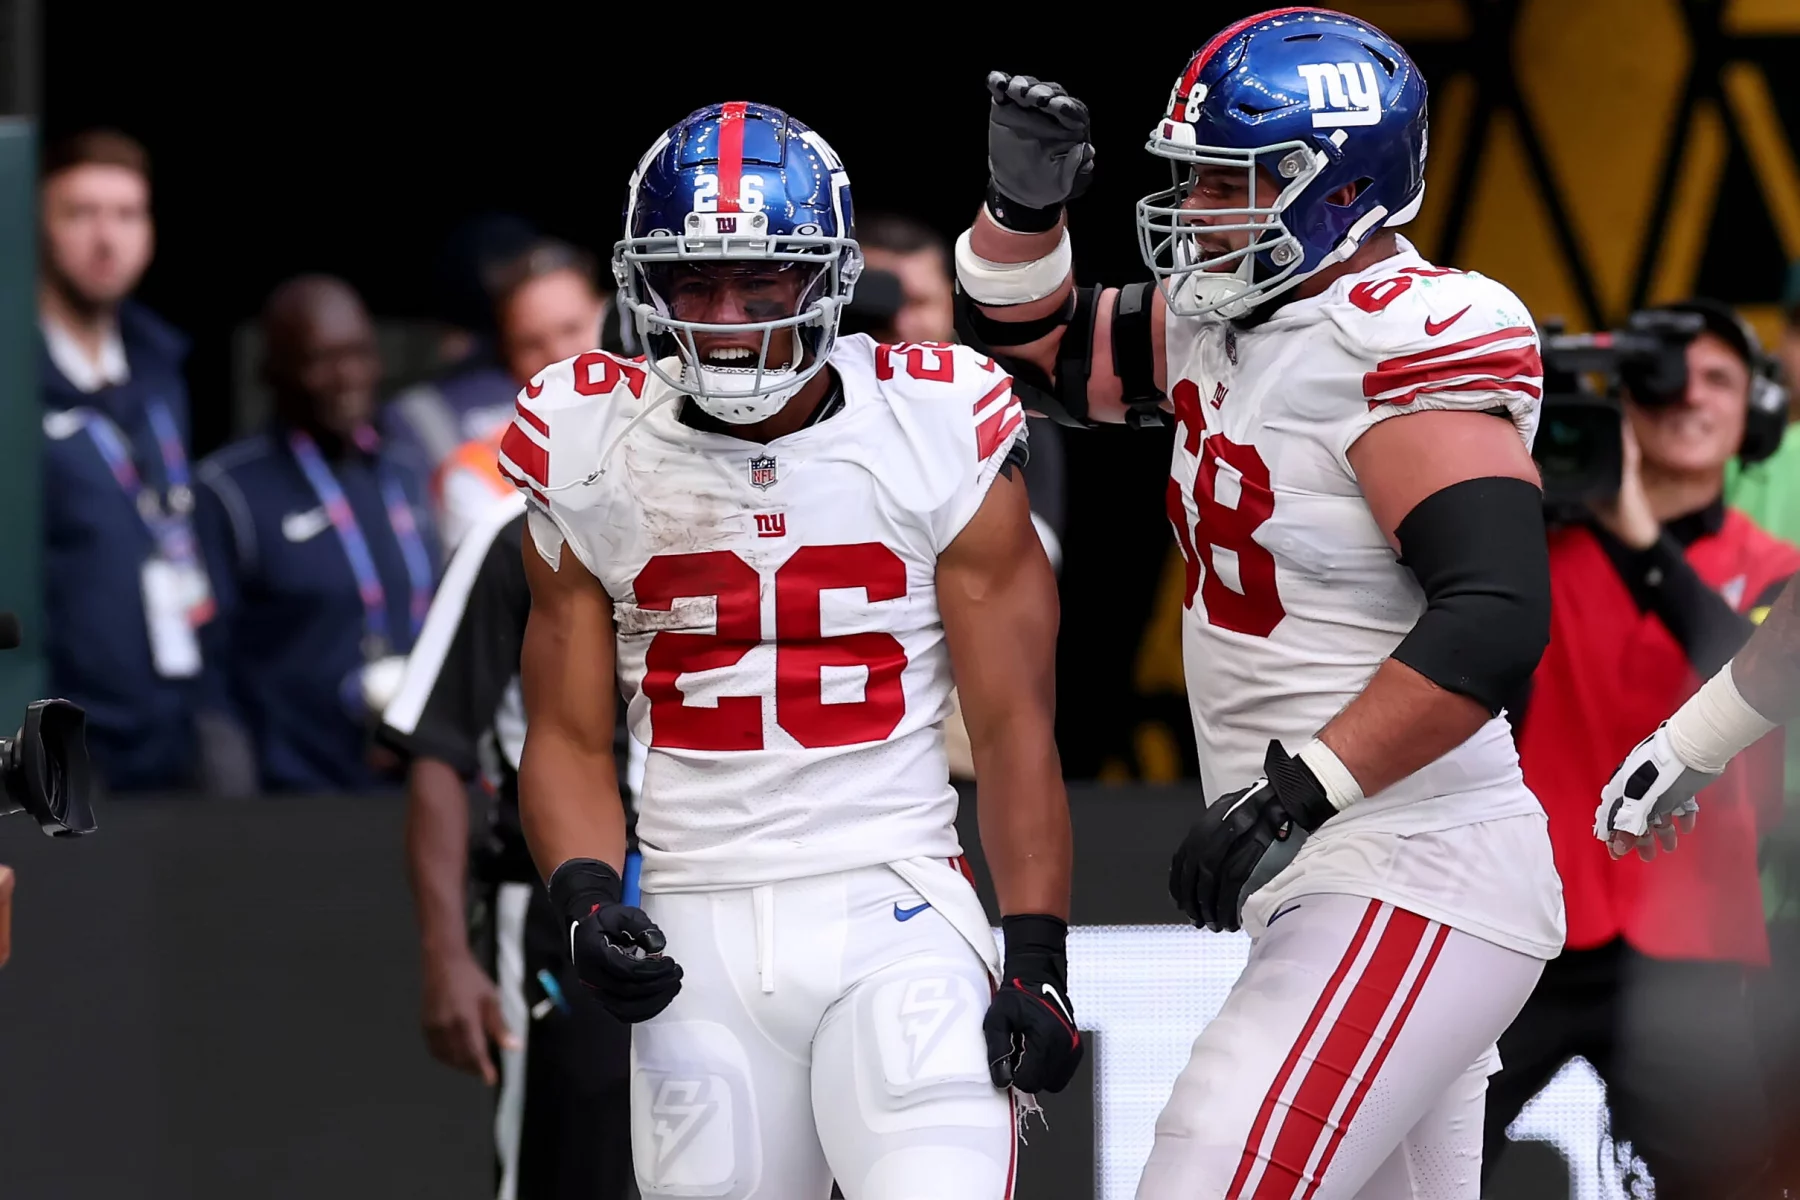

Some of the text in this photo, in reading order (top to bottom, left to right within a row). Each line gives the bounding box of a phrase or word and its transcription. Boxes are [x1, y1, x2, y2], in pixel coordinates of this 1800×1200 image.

[694, 174, 764, 213] 26
[753, 469, 775, 484] NFL
[632, 541, 908, 751] 26
